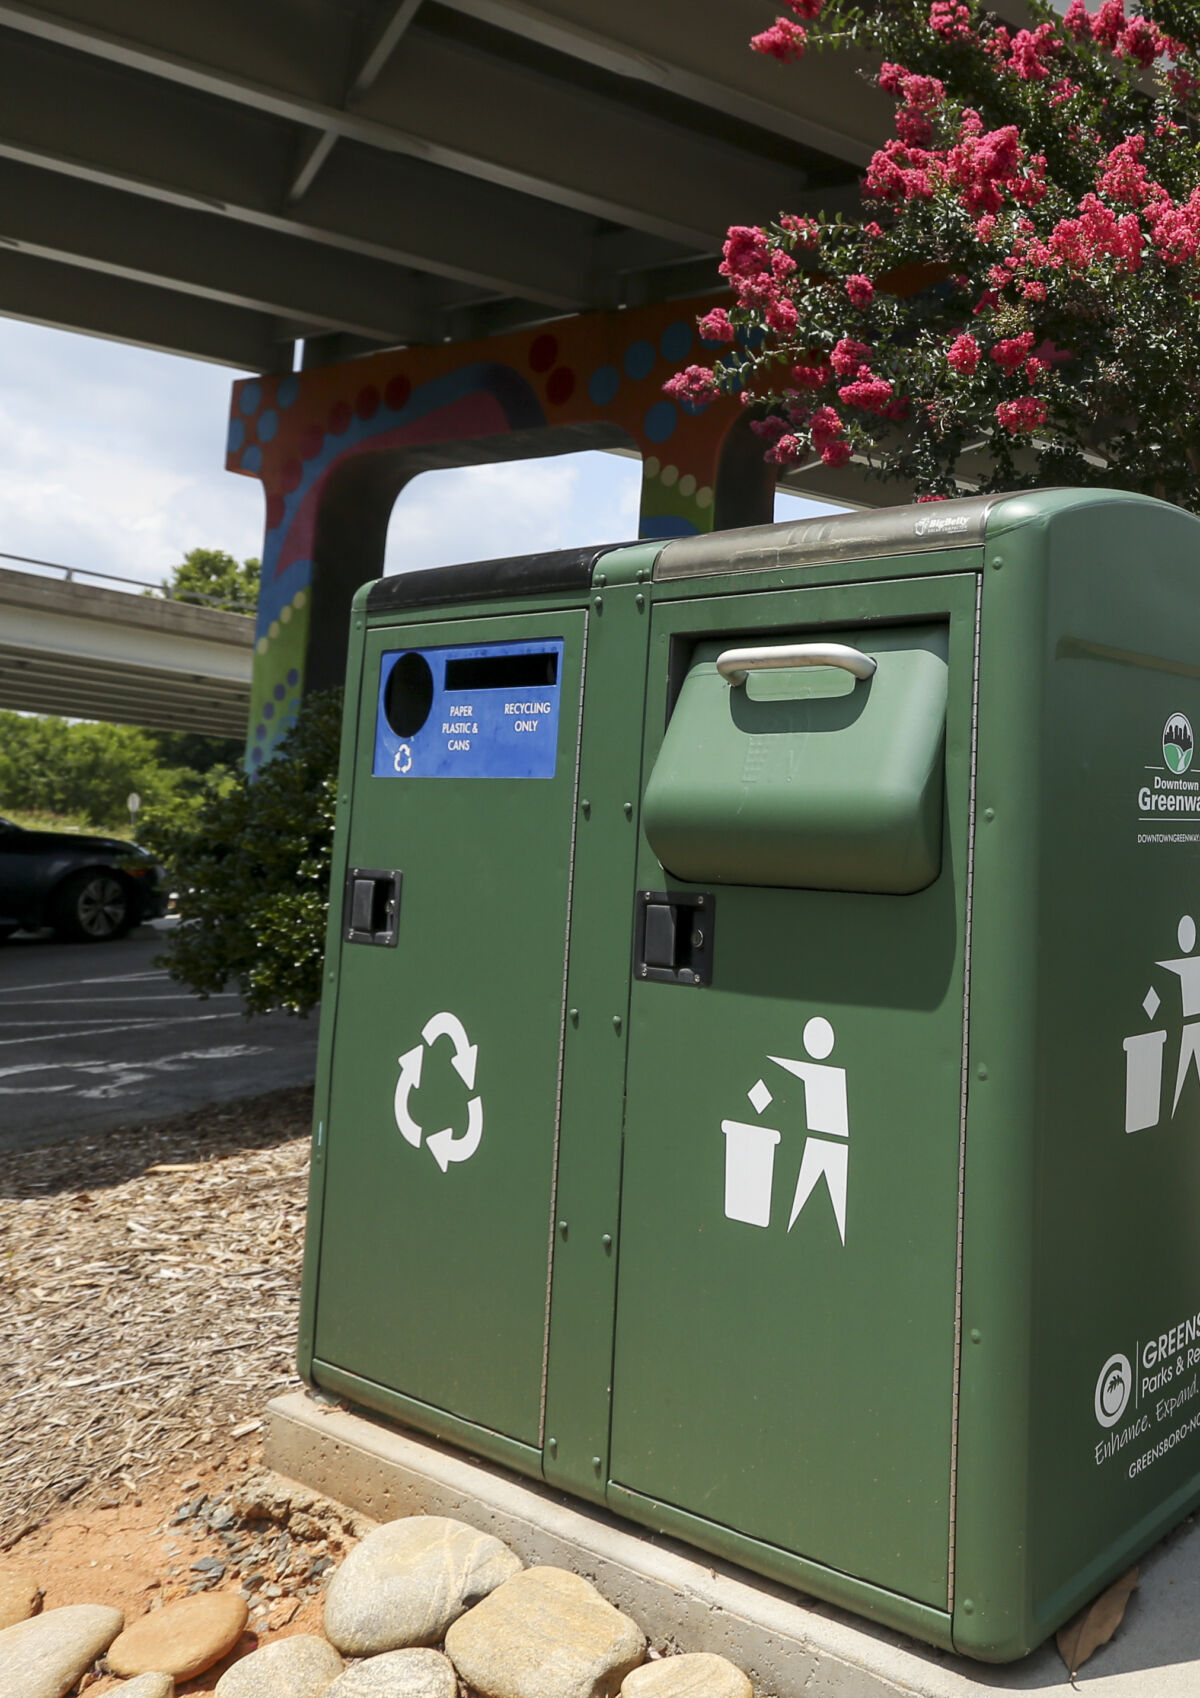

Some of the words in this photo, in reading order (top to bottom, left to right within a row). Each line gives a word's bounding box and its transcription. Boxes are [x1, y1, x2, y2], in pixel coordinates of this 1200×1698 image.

[450, 706, 473, 717] PAPER
[504, 702, 551, 715] RECYCLING
[442, 722, 470, 734] PLASTIC
[472, 722, 479, 734] &
[514, 720, 538, 732] ONLY
[448, 739, 470, 751] CANS
[1154, 776, 1199, 791] Downtown
[1141, 1365, 1173, 1399] Parks
[1175, 1356, 1185, 1376] &
[1094, 1414, 1152, 1466] Enhance.
[1155, 1374, 1199, 1422] Expand.
